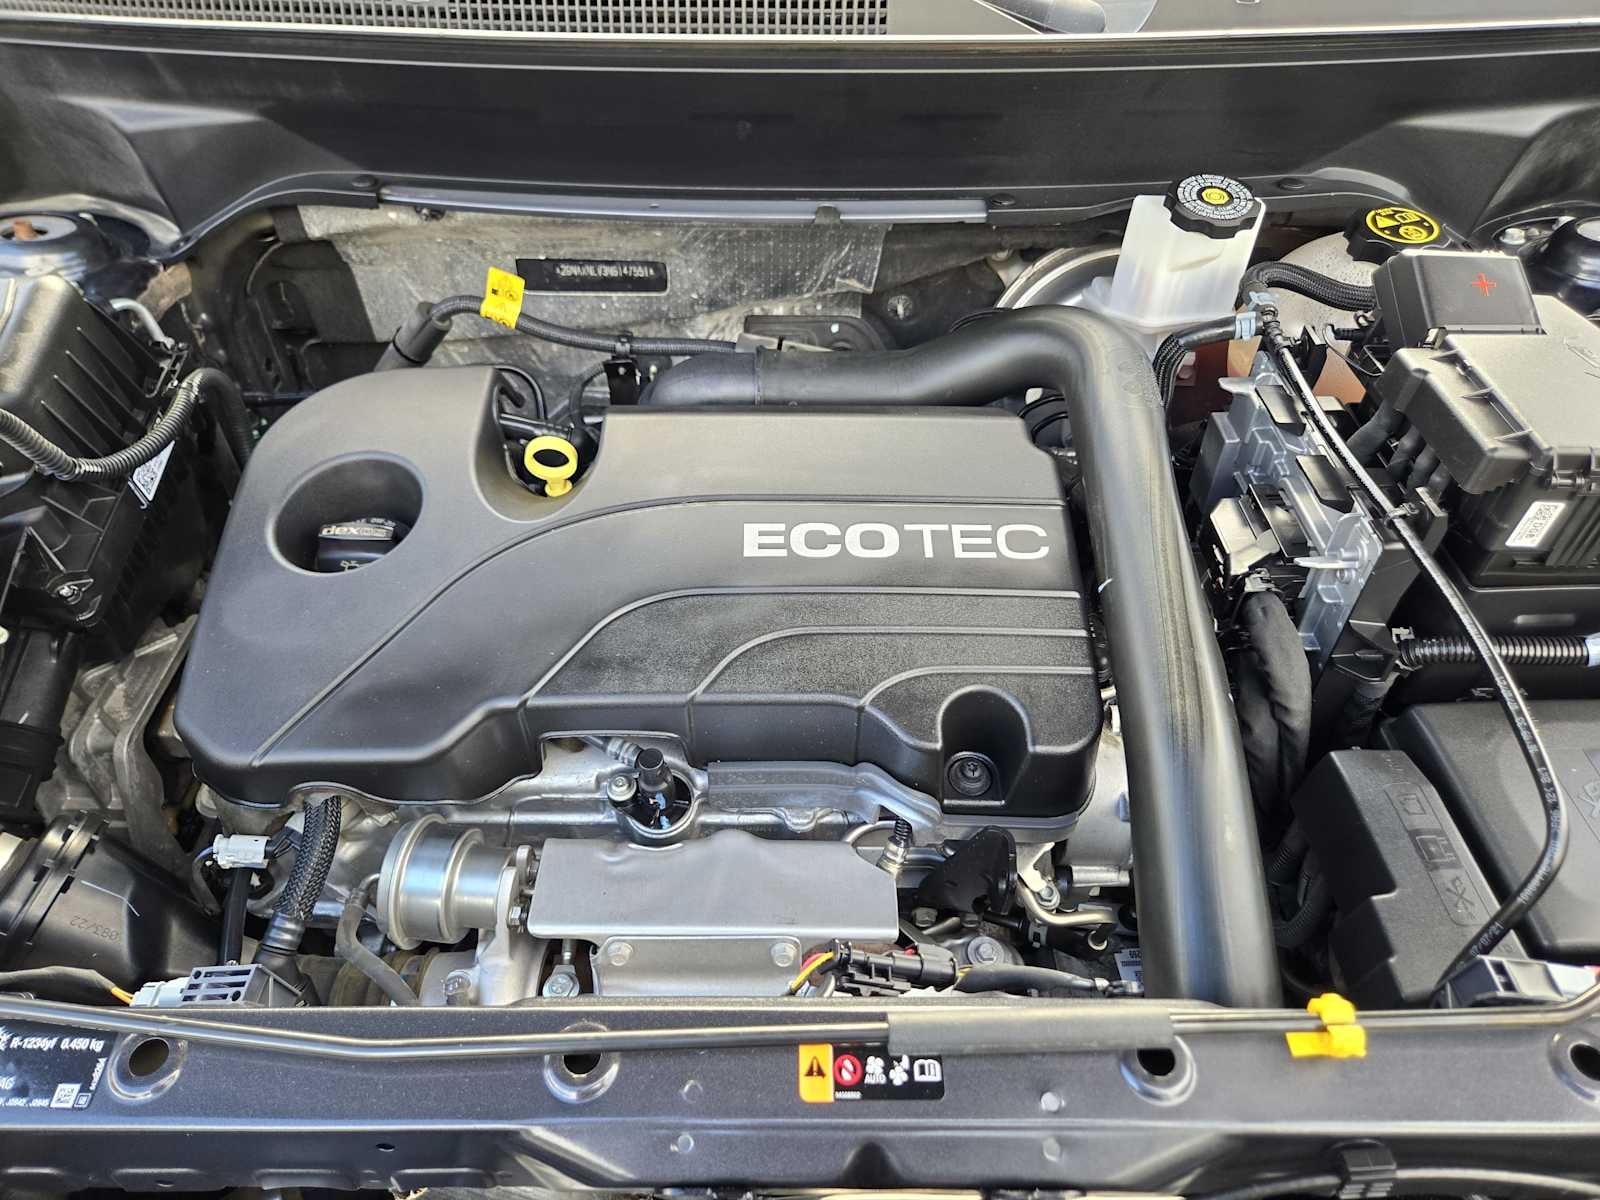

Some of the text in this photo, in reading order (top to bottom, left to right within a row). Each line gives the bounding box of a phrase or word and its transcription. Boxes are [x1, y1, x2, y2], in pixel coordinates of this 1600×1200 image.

[743, 522, 1050, 560] ECOTEC
[10, 1036, 105, 1053] R-1234yf 0.450 kg
